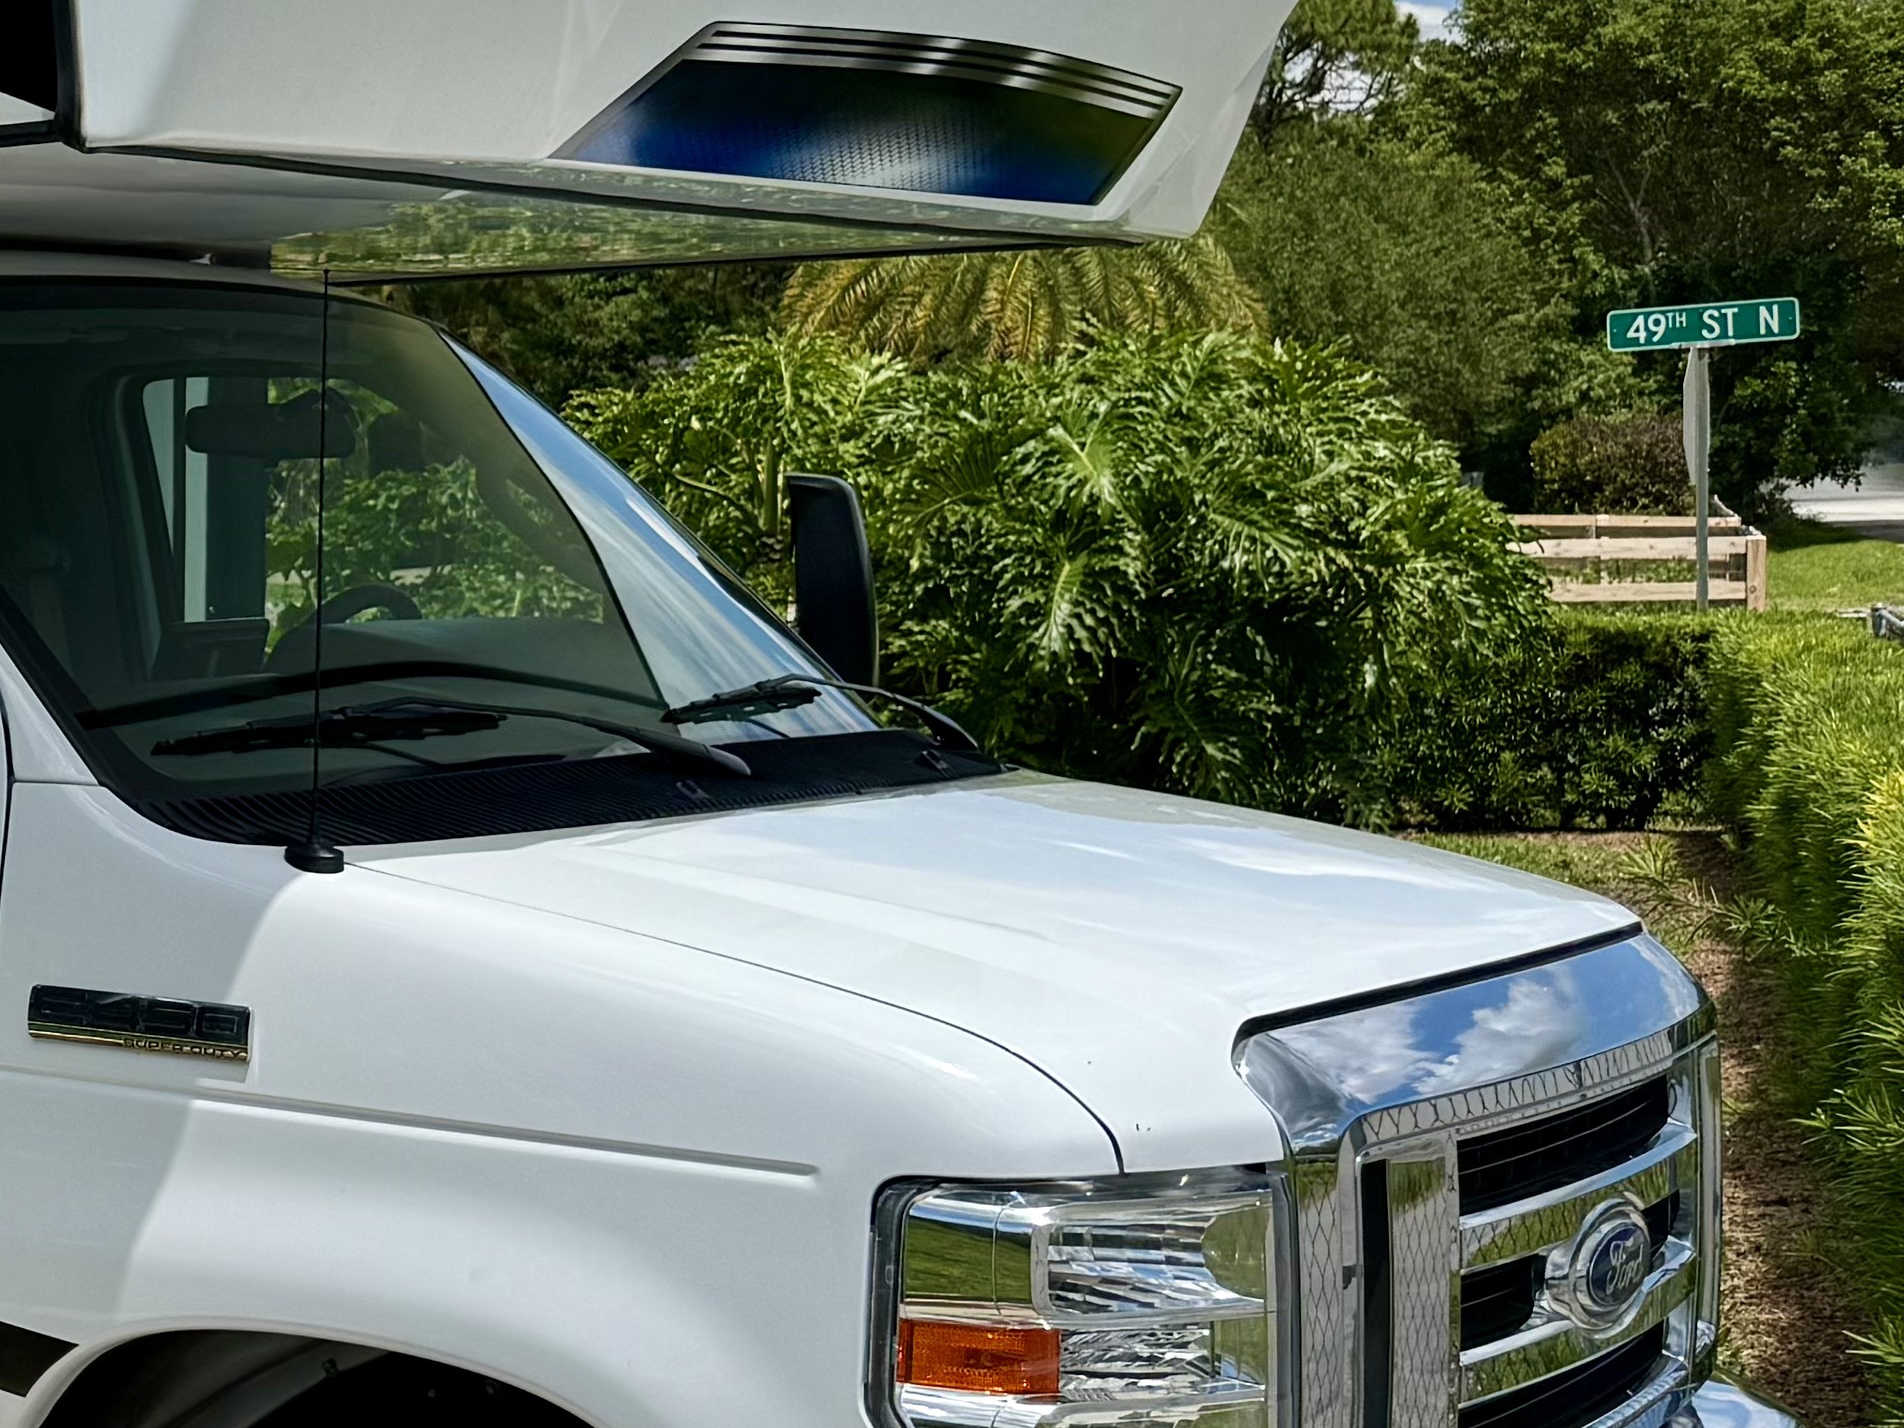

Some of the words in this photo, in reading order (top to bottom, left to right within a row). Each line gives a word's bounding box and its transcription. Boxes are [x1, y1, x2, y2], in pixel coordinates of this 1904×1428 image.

[1626, 311, 1687, 344] 49TH
[1701, 307, 1739, 339] ST
[1759, 304, 1780, 335] N
[1606, 1237, 1645, 1295] Ford
